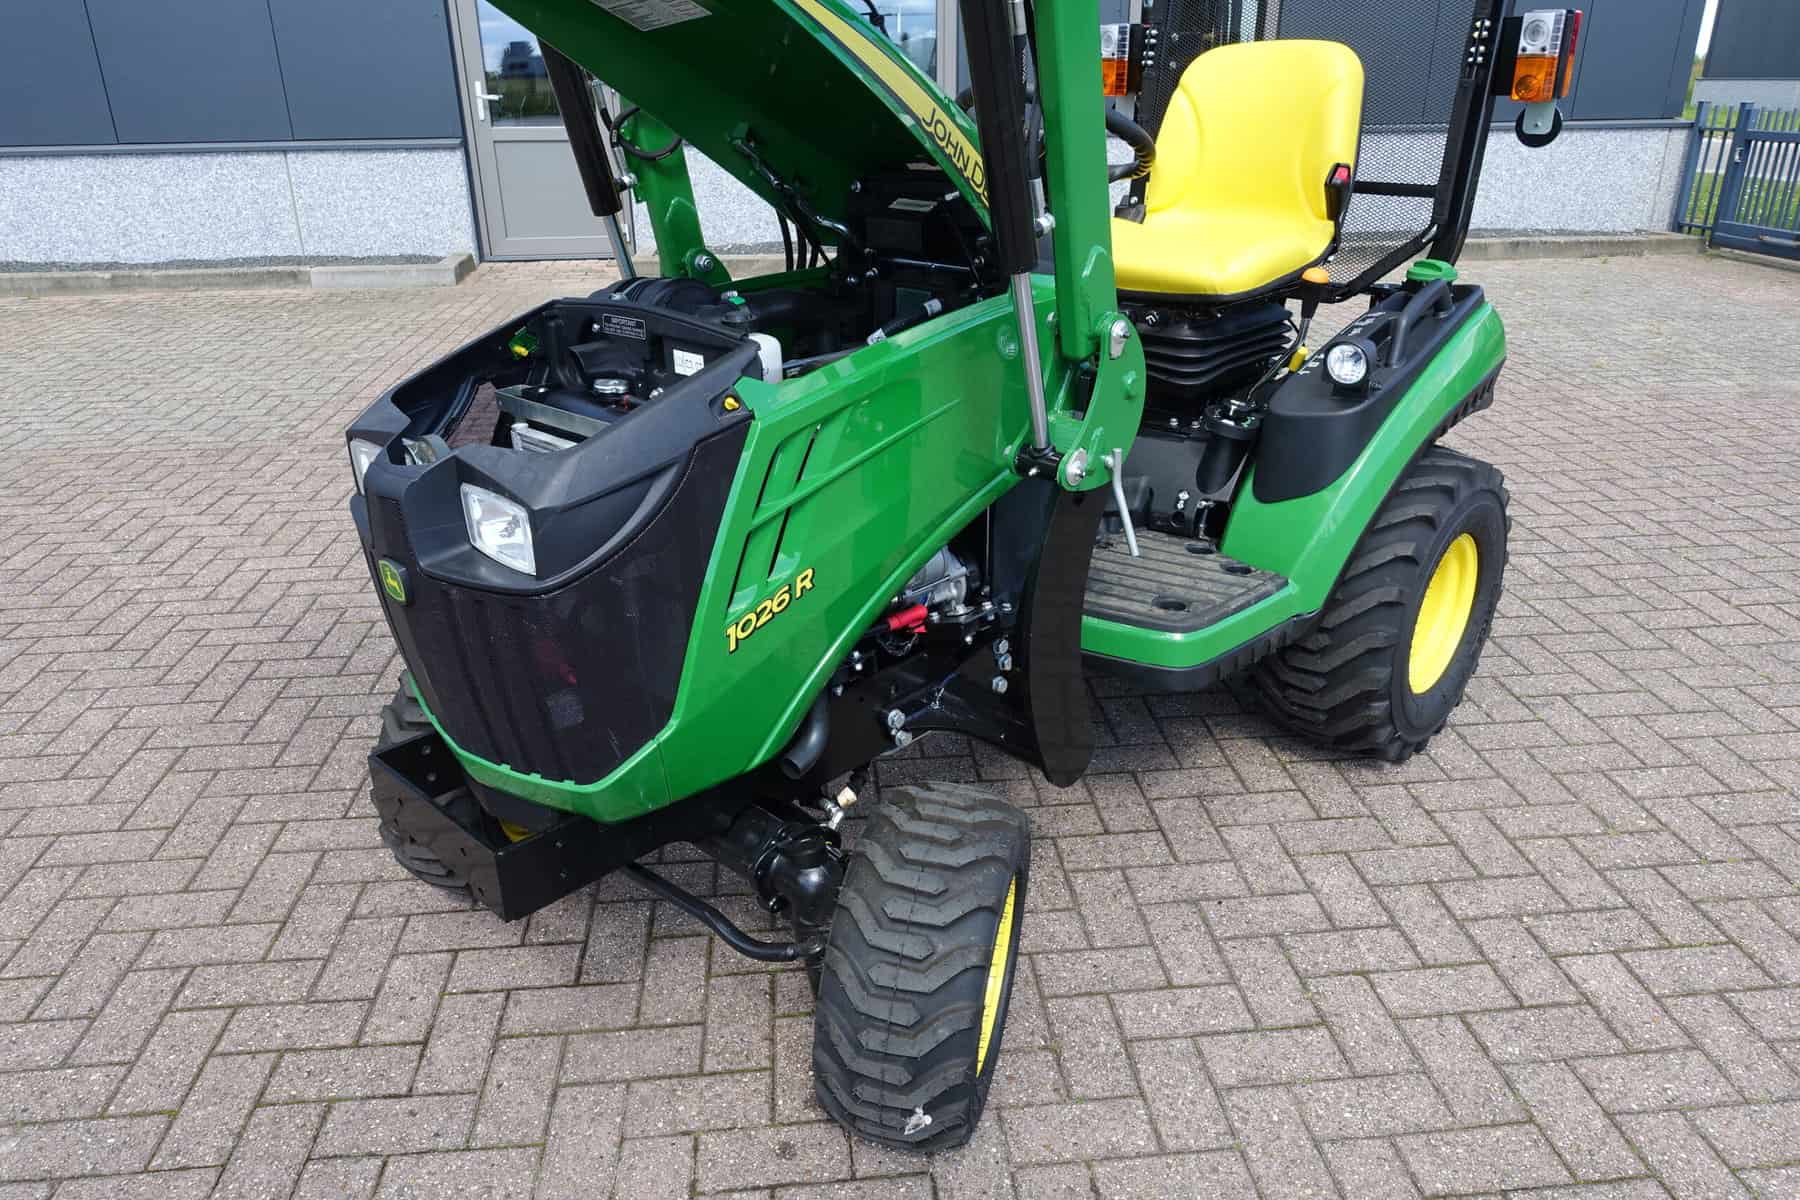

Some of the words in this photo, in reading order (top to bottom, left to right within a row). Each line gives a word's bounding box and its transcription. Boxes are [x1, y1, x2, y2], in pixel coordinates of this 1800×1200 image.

[921, 107, 970, 173] JOHN
[726, 583, 792, 655] 1026
[795, 567, 816, 600] R
